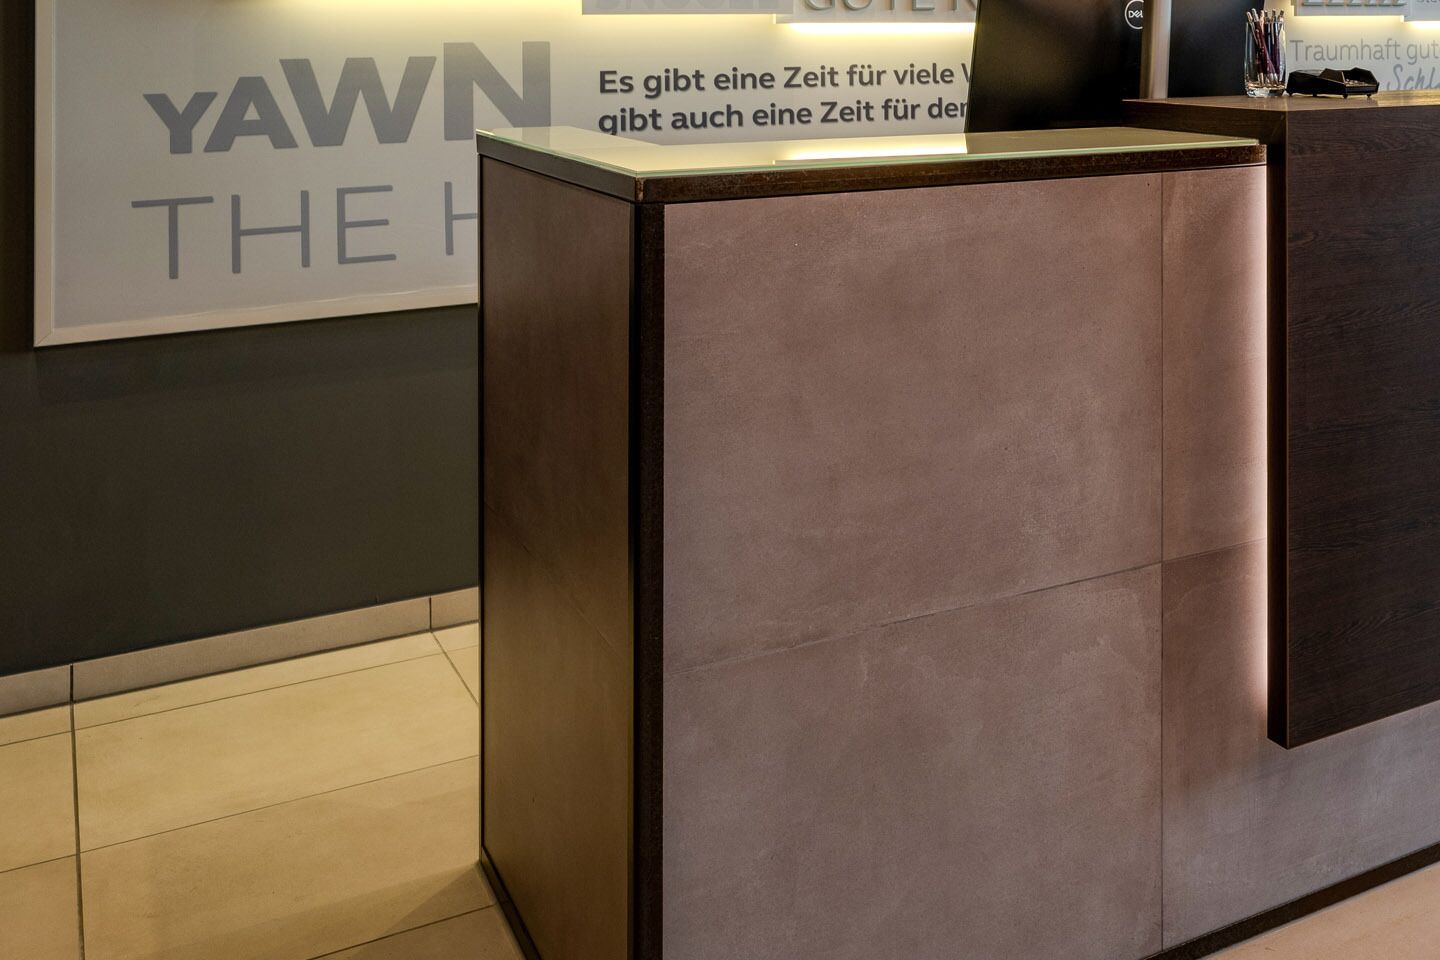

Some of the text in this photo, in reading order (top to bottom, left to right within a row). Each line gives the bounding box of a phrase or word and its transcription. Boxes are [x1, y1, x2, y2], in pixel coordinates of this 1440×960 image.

[1290, 38, 1400, 62] Traumhaft
[143, 41, 550, 155] YAWN
[599, 70, 634, 94] Es
[643, 66, 705, 100] gibt
[713, 65, 775, 90] eine
[783, 64, 838, 88] Zeit
[846, 63, 886, 87] für
[894, 63, 954, 85] viele
[598, 101, 662, 134] gibt
[670, 103, 743, 131] auch
[752, 102, 813, 127] eine
[820, 99, 874, 123] Zeit
[881, 98, 921, 120] für
[131, 184, 397, 280] THE
